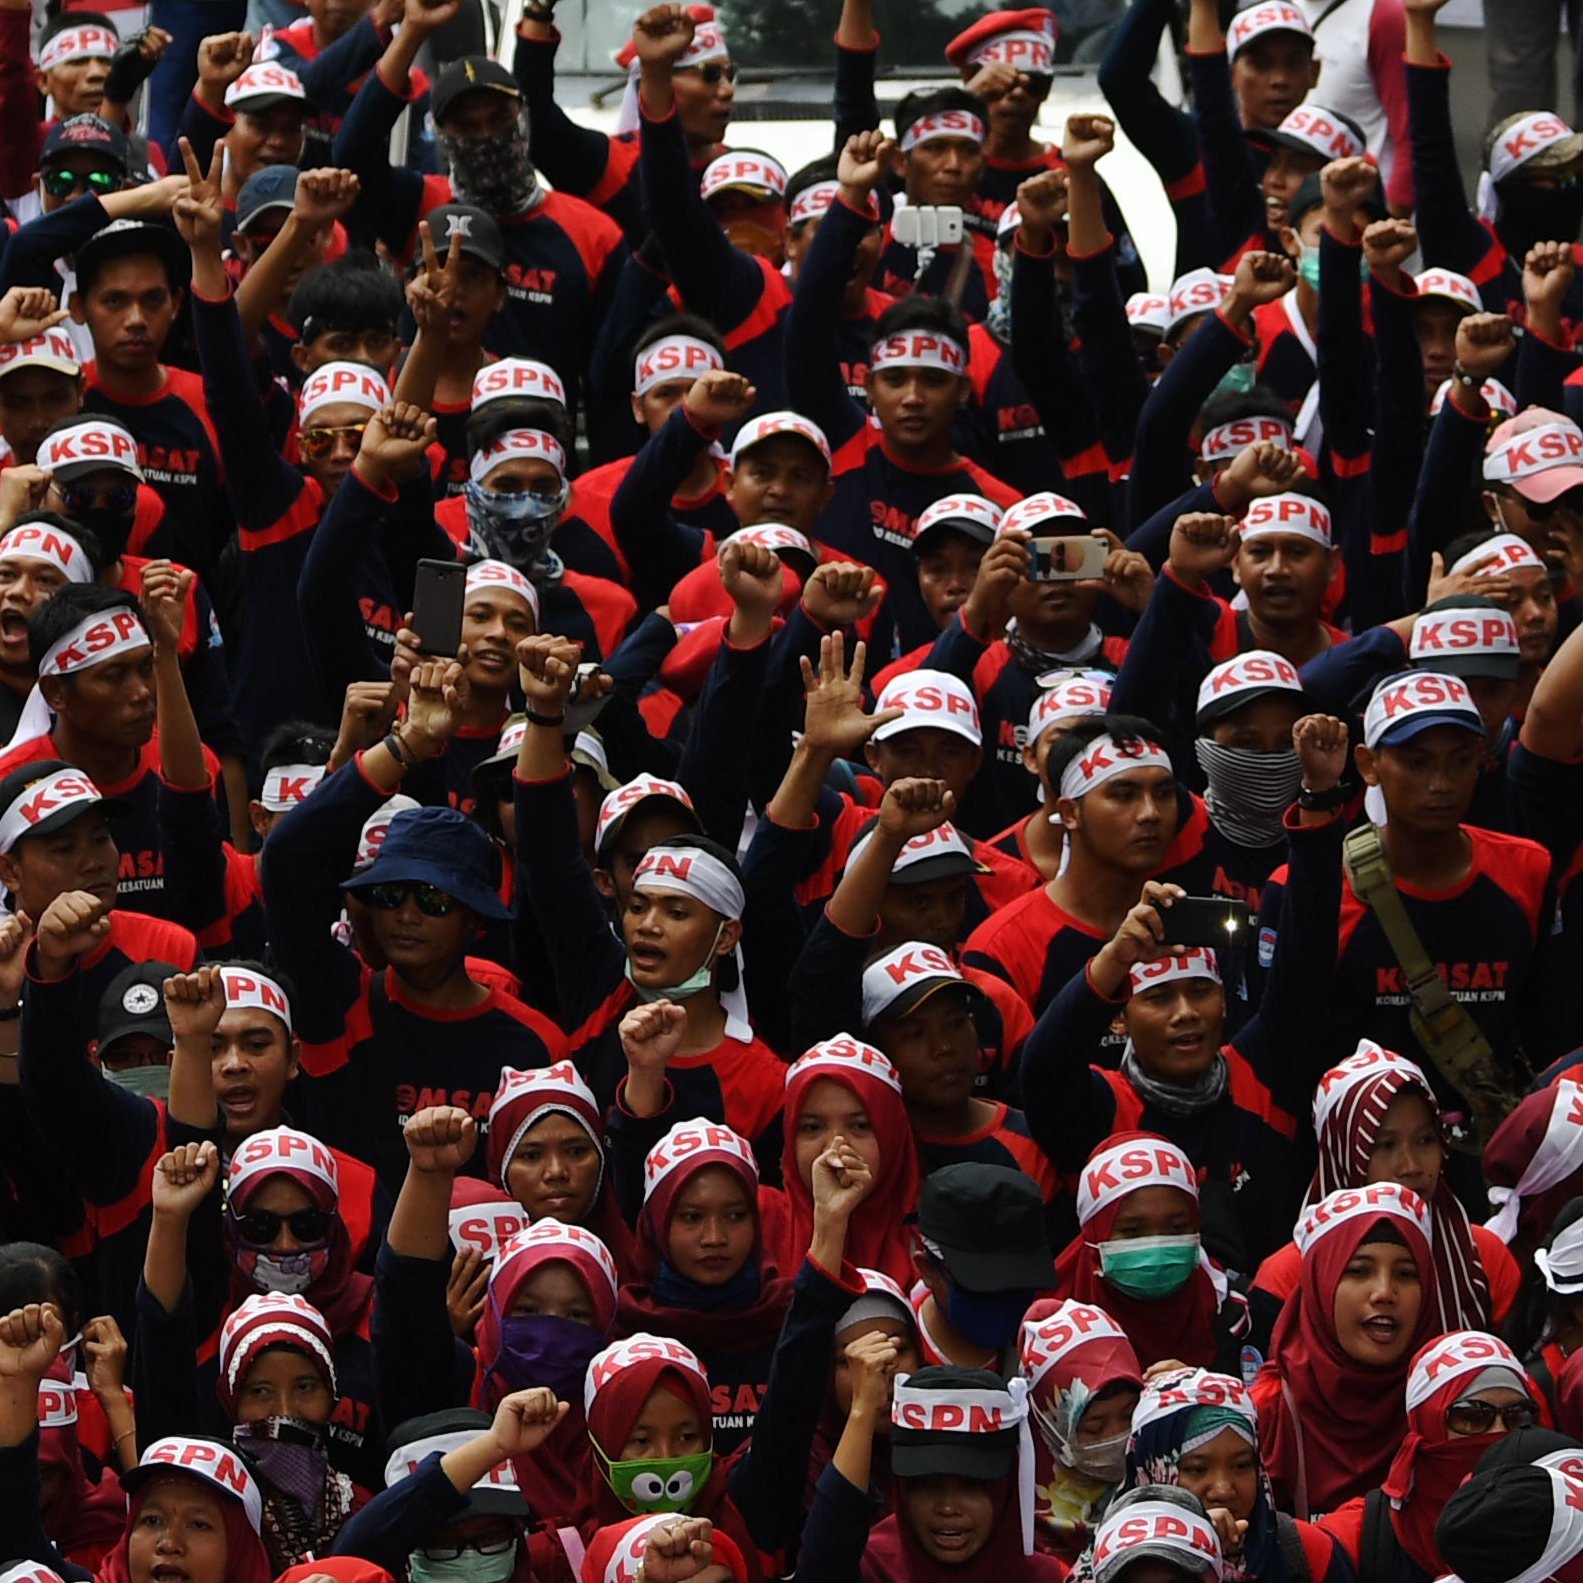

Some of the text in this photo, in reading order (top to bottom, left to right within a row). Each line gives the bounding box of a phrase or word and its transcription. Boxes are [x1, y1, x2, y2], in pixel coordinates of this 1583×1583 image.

[1232, 4, 1302, 40] KSP
[980, 39, 1049, 68] SPN
[1287, 110, 1357, 160] SPN
[1210, 421, 1292, 452] KSP
[167, 471, 198, 485] KSPN
[53, 612, 143, 672] KSP
[1211, 658, 1298, 693] KSP
[1382, 677, 1472, 718] KSP
[19, 769, 99, 825] KSP
[117, 879, 164, 894] KESATUAN
[1424, 1336, 1520, 1381] KSP
[150, 1442, 248, 1493] SPN
